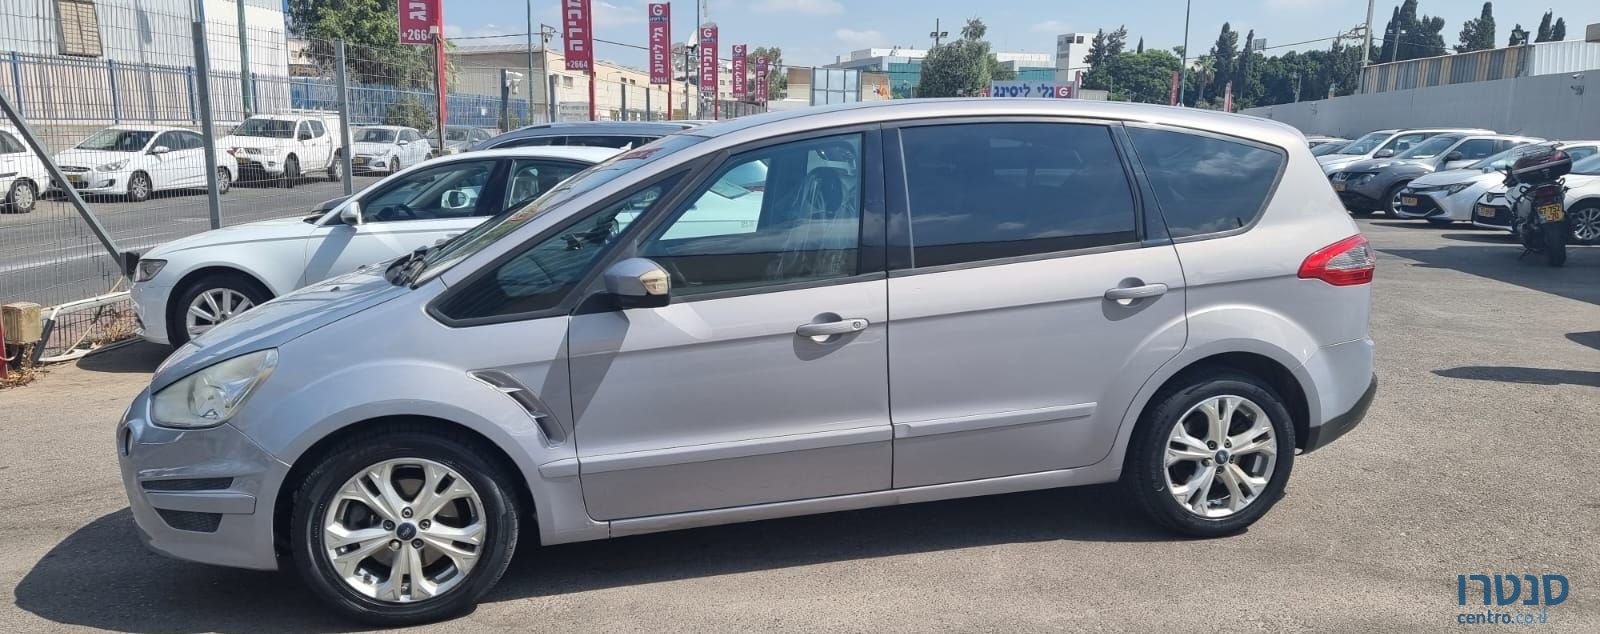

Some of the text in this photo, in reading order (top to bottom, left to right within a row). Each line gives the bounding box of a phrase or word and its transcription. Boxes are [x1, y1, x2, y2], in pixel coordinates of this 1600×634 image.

[652, 4, 663, 16] G
[653, 27, 664, 41] גלי
[703, 28, 713, 38] G
[653, 44, 664, 73] ליסינג
[703, 47, 713, 81] מכירה
[993, 83, 1055, 98] גלי ליסינג
[1058, 87, 1069, 97] G
